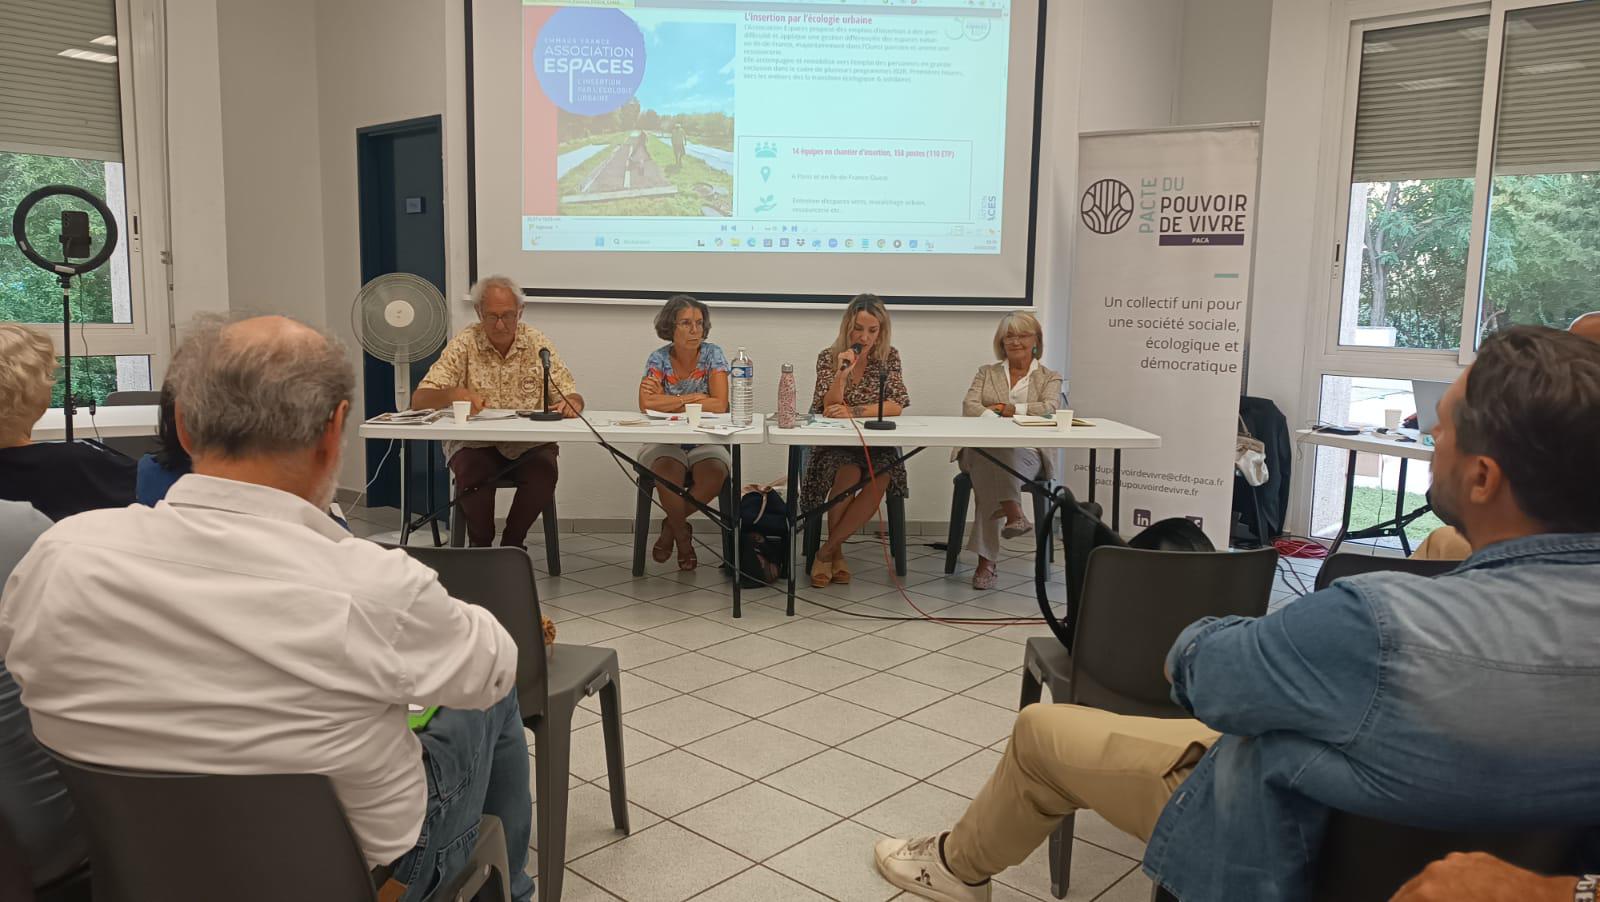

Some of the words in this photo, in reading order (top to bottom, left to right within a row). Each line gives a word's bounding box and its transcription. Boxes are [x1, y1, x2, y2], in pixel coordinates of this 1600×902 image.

[842, 15, 873, 25] urbaine
[544, 45, 634, 57] ASSOCIATION
[1162, 176, 1185, 192] DU
[1138, 177, 1157, 233] PACTE
[1160, 194, 1248, 214] POUVOIR
[1159, 216, 1183, 233] DE
[1189, 215, 1247, 233] VIVRE
[1104, 296, 1123, 308] Un
[1126, 296, 1179, 309] collectif
[1182, 297, 1203, 310] uni
[1207, 299, 1243, 313] pour
[1108, 317, 1134, 328] une
[1137, 317, 1185, 330] société
[1188, 318, 1241, 333] sociale,
[1145, 337, 1220, 354] écologique
[1224, 341, 1239, 352] et
[1140, 357, 1238, 375] démocratique
[1136, 513, 1149, 527] in
